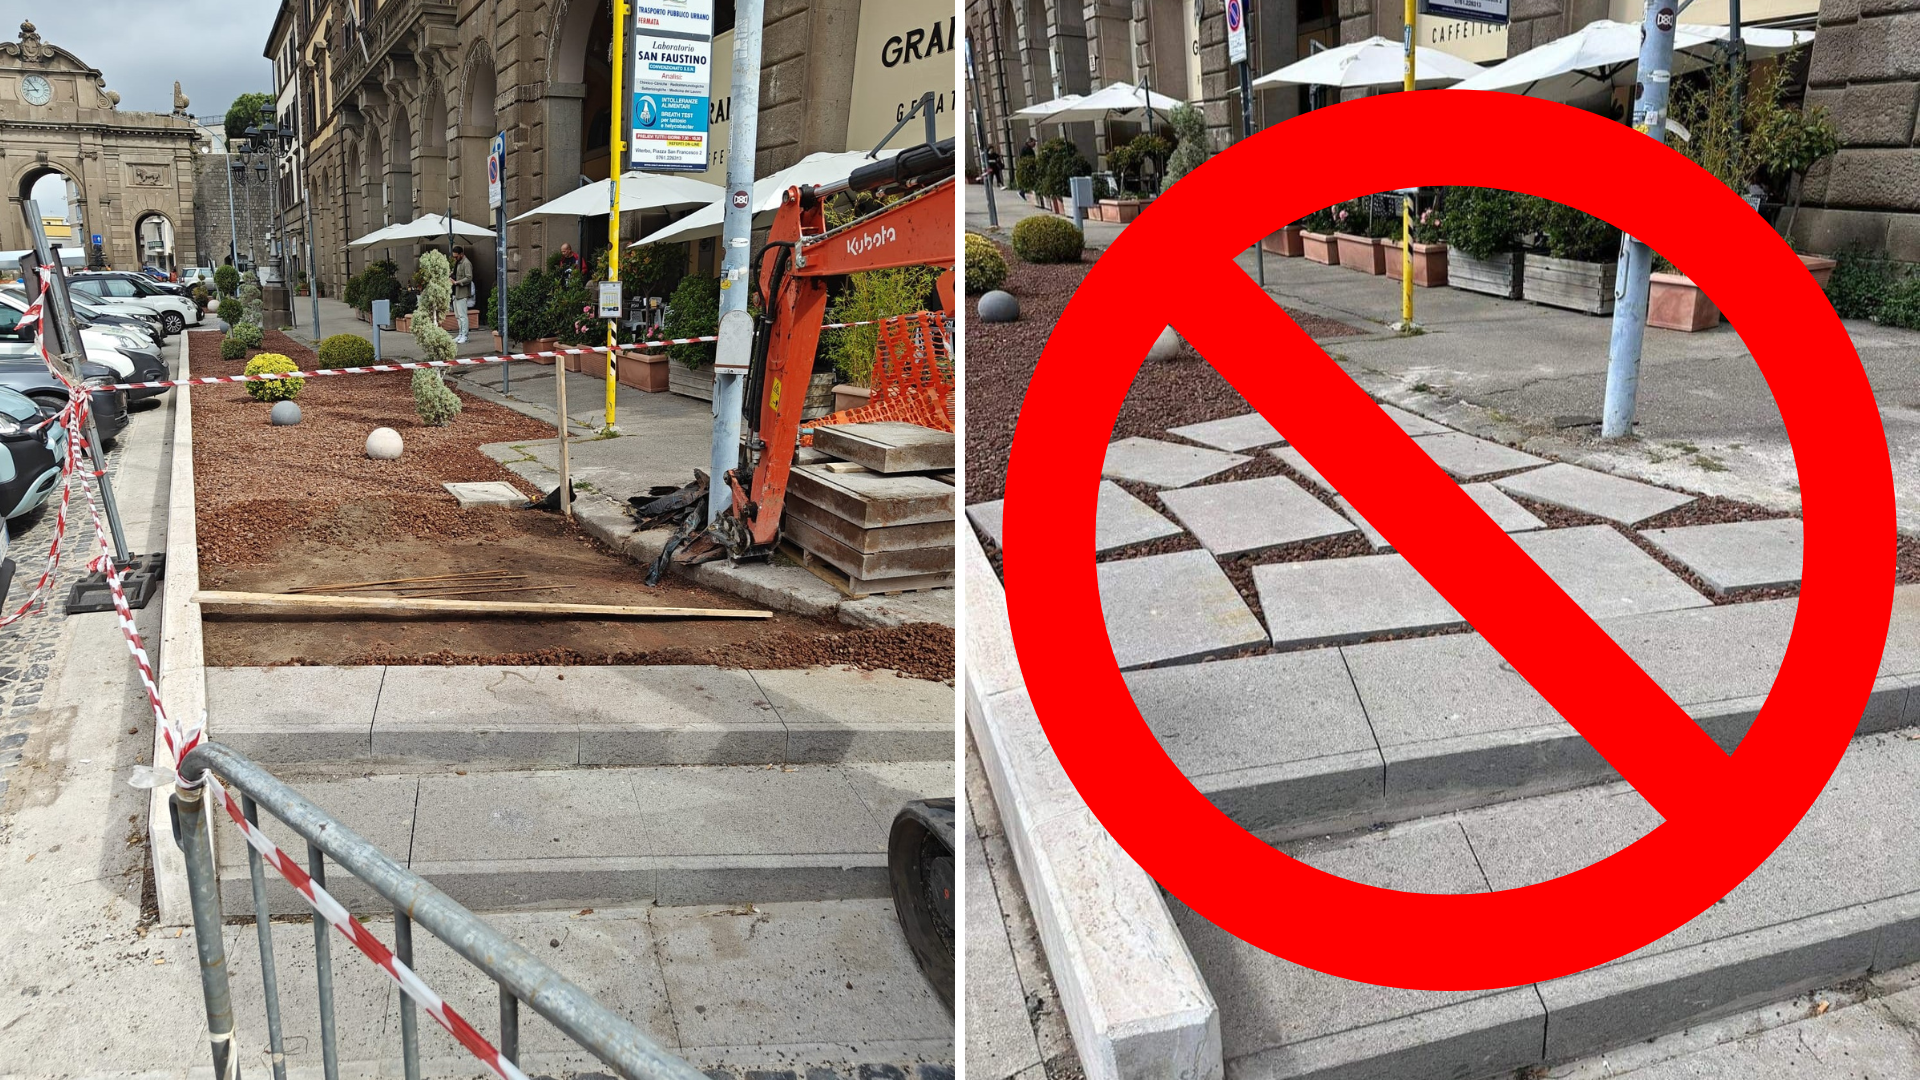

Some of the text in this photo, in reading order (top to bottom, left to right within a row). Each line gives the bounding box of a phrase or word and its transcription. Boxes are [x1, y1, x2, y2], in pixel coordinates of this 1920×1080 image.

[639, 7, 666, 15] TRASPORTO
[667, 10, 689, 18] PUBBLICO
[638, 17, 659, 25] FERMATA
[652, 41, 695, 52] Laboratorio
[638, 51, 707, 65] SAN FAUSTINO
[847, 225, 896, 255] Kubota
